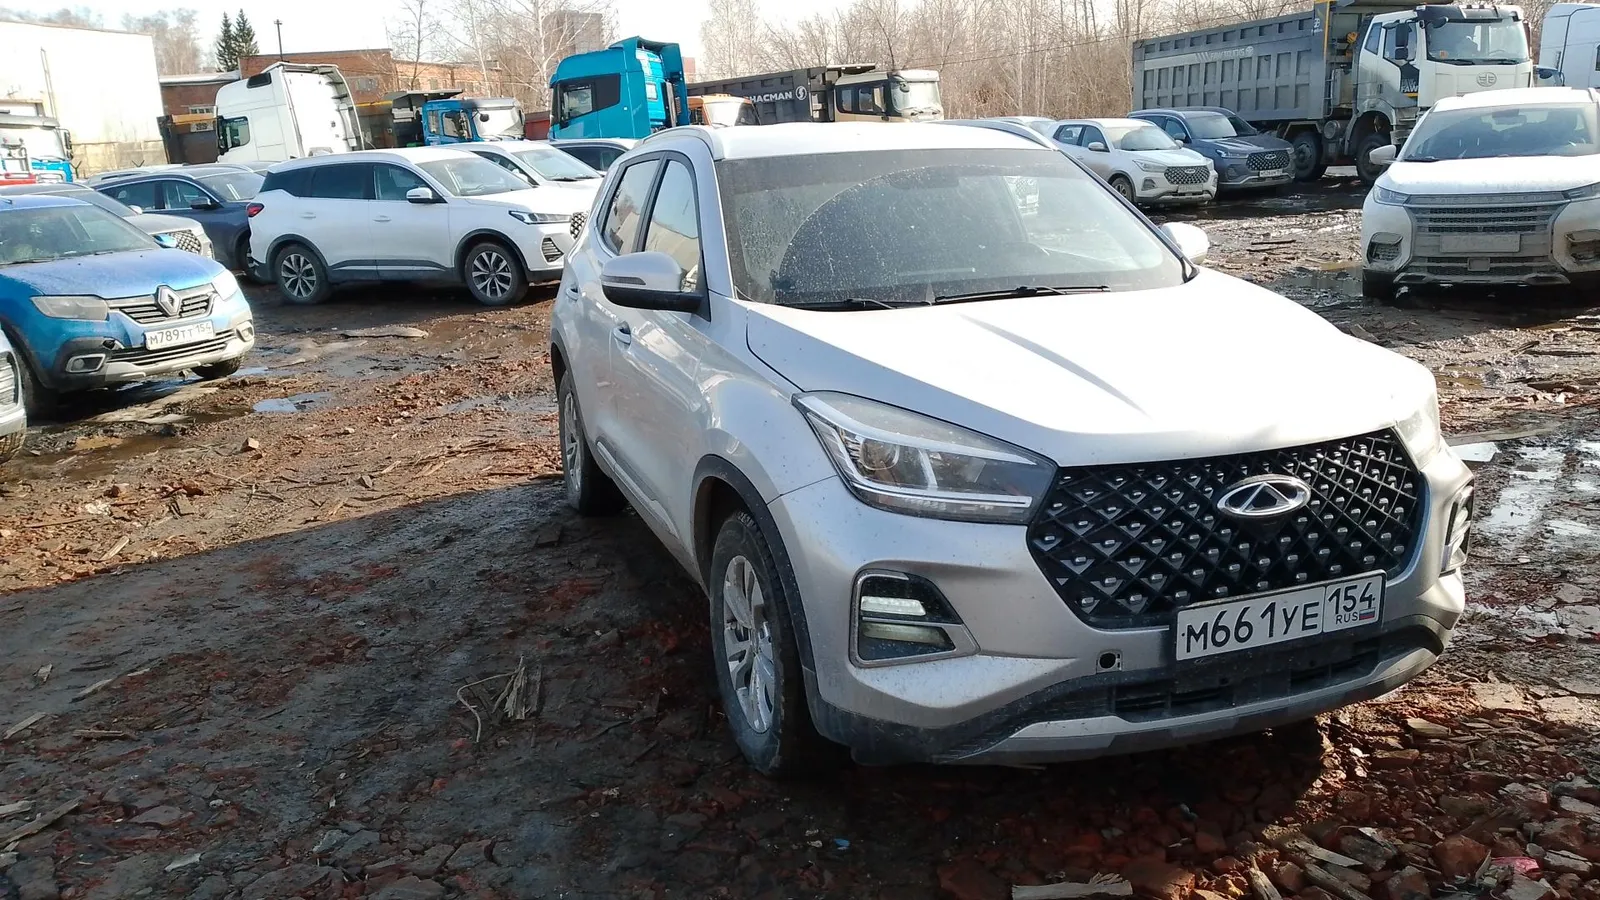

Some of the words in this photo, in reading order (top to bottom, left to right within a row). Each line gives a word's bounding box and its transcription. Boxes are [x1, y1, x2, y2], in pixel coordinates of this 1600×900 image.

[747, 91, 793, 103] HACMAN
[149, 328, 193, 345] М789ТТ
[195, 322, 211, 333] 154
[1186, 601, 1320, 654] М661УЕ
[1327, 582, 1375, 615] 154
[1335, 611, 1359, 625] RUS
